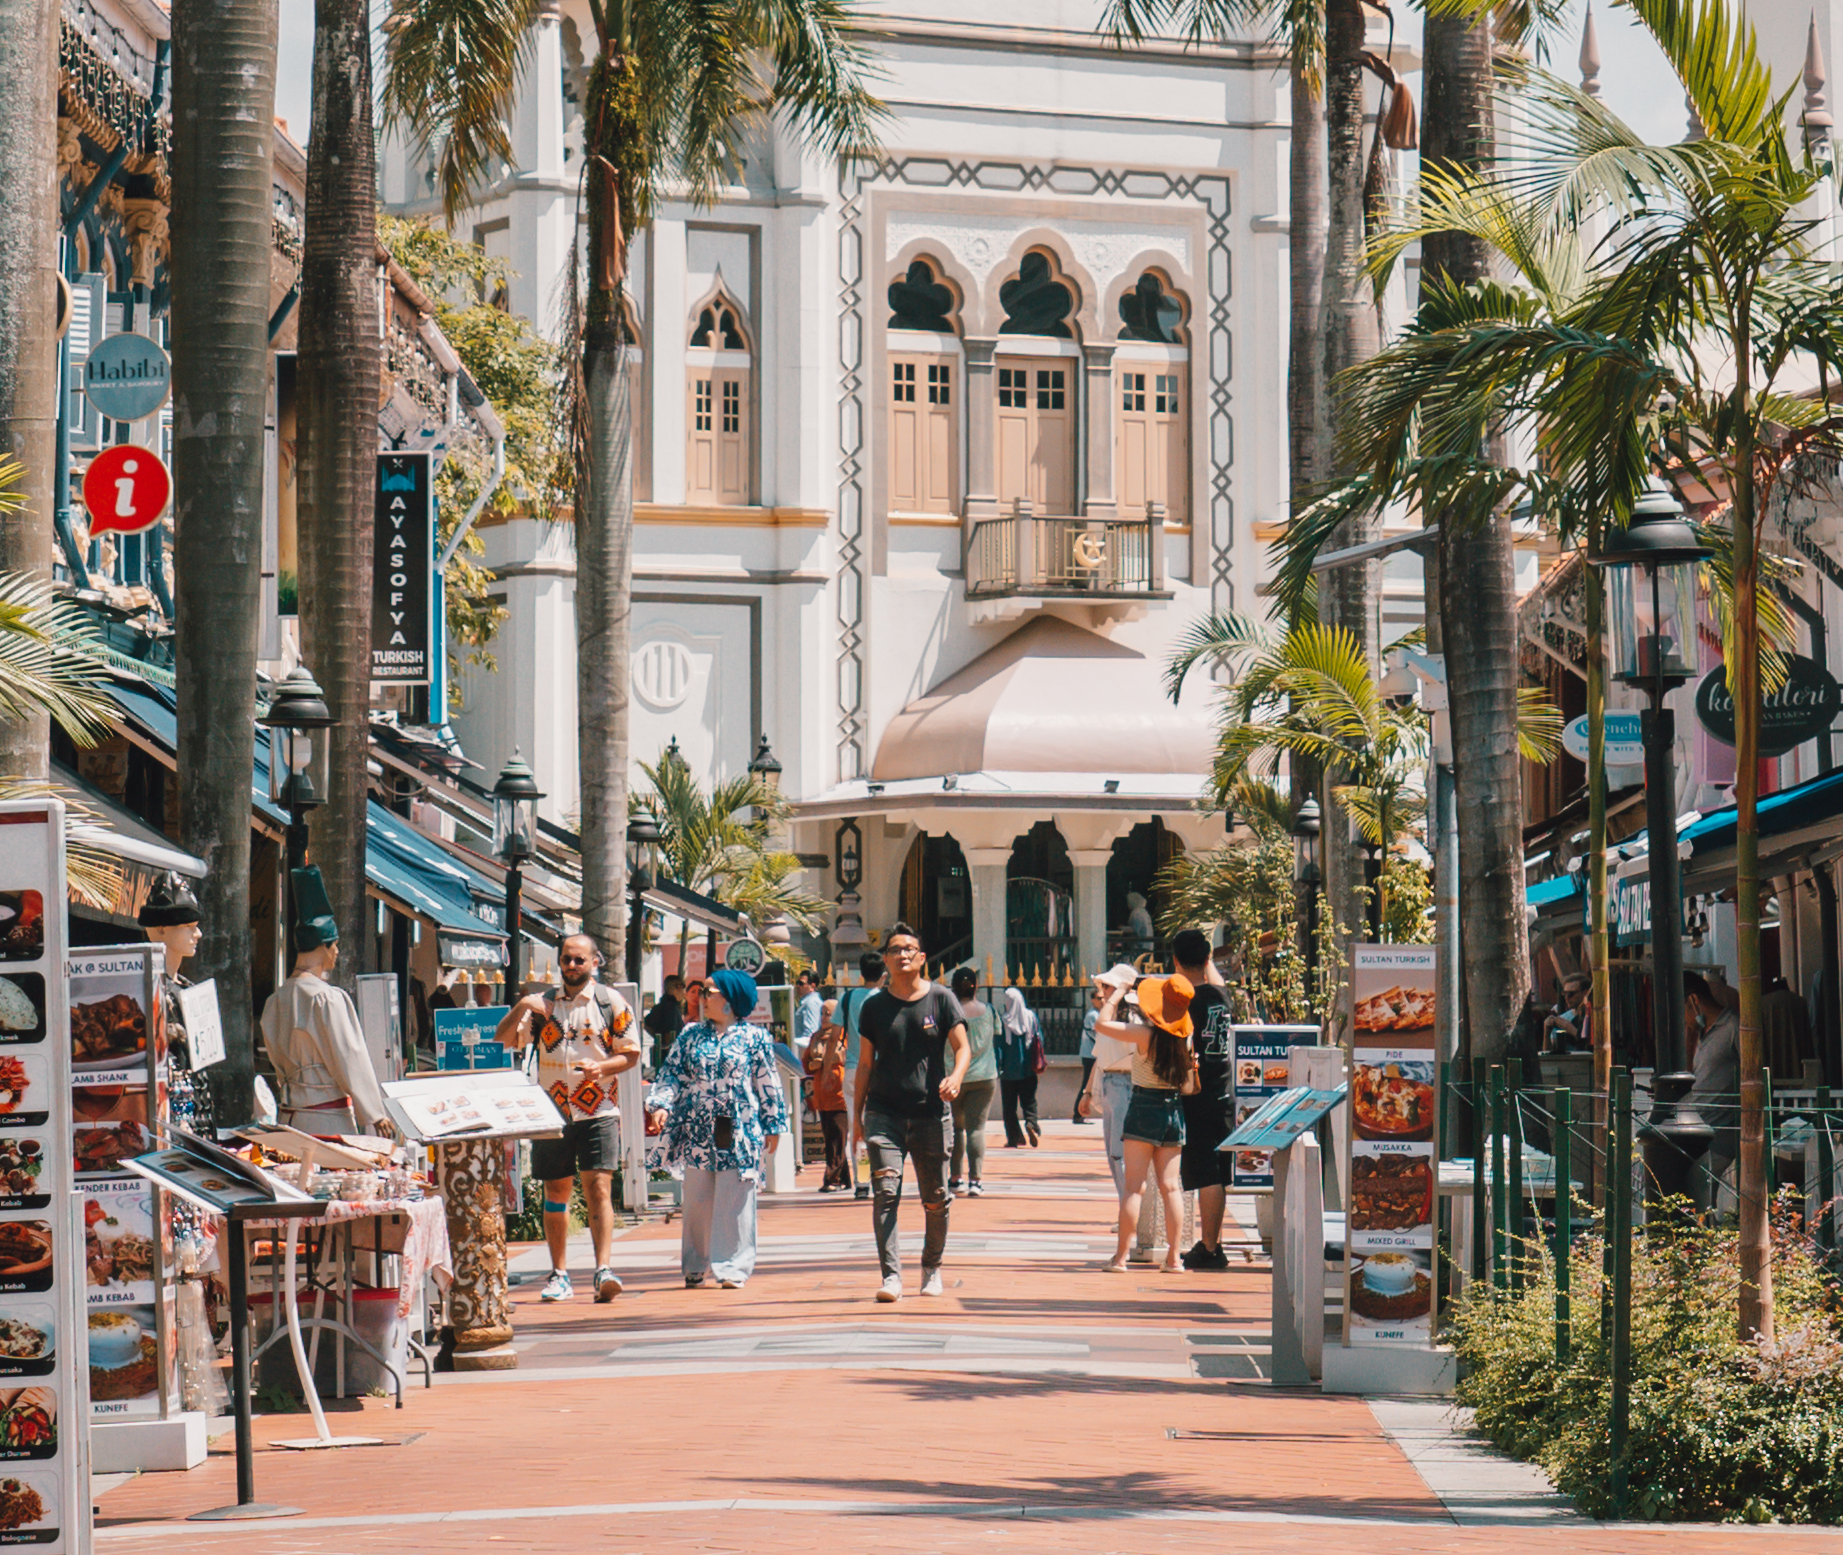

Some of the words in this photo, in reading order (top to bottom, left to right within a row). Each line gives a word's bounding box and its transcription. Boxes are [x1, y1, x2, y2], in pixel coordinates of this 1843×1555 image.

[89, 358, 164, 380] Habibi
[389, 495, 407, 645] AYASOFYA
[372, 650, 424, 665] TURKISH
[372, 665, 424, 676] RESTAURANT
[1361, 955, 1392, 963] SULTAN
[1395, 955, 1430, 963] TURKISH
[85, 963, 95, 973] @
[98, 960, 143, 973] SULTAN
[1238, 1046, 1273, 1056] SULTAN
[1386, 1051, 1403, 1059] PIDE
[97, 1073, 129, 1083] SHANK
[1373, 1143, 1412, 1152] MUSAKKA
[112, 1181, 141, 1192] KEBAB
[1367, 1236, 1393, 1245] MIXED
[1395, 1238, 1416, 1246] GRILL
[106, 1292, 135, 1303] KEBAB
[1375, 1330, 1405, 1340] KUNEFE
[94, 1403, 129, 1414] KUNEFE
